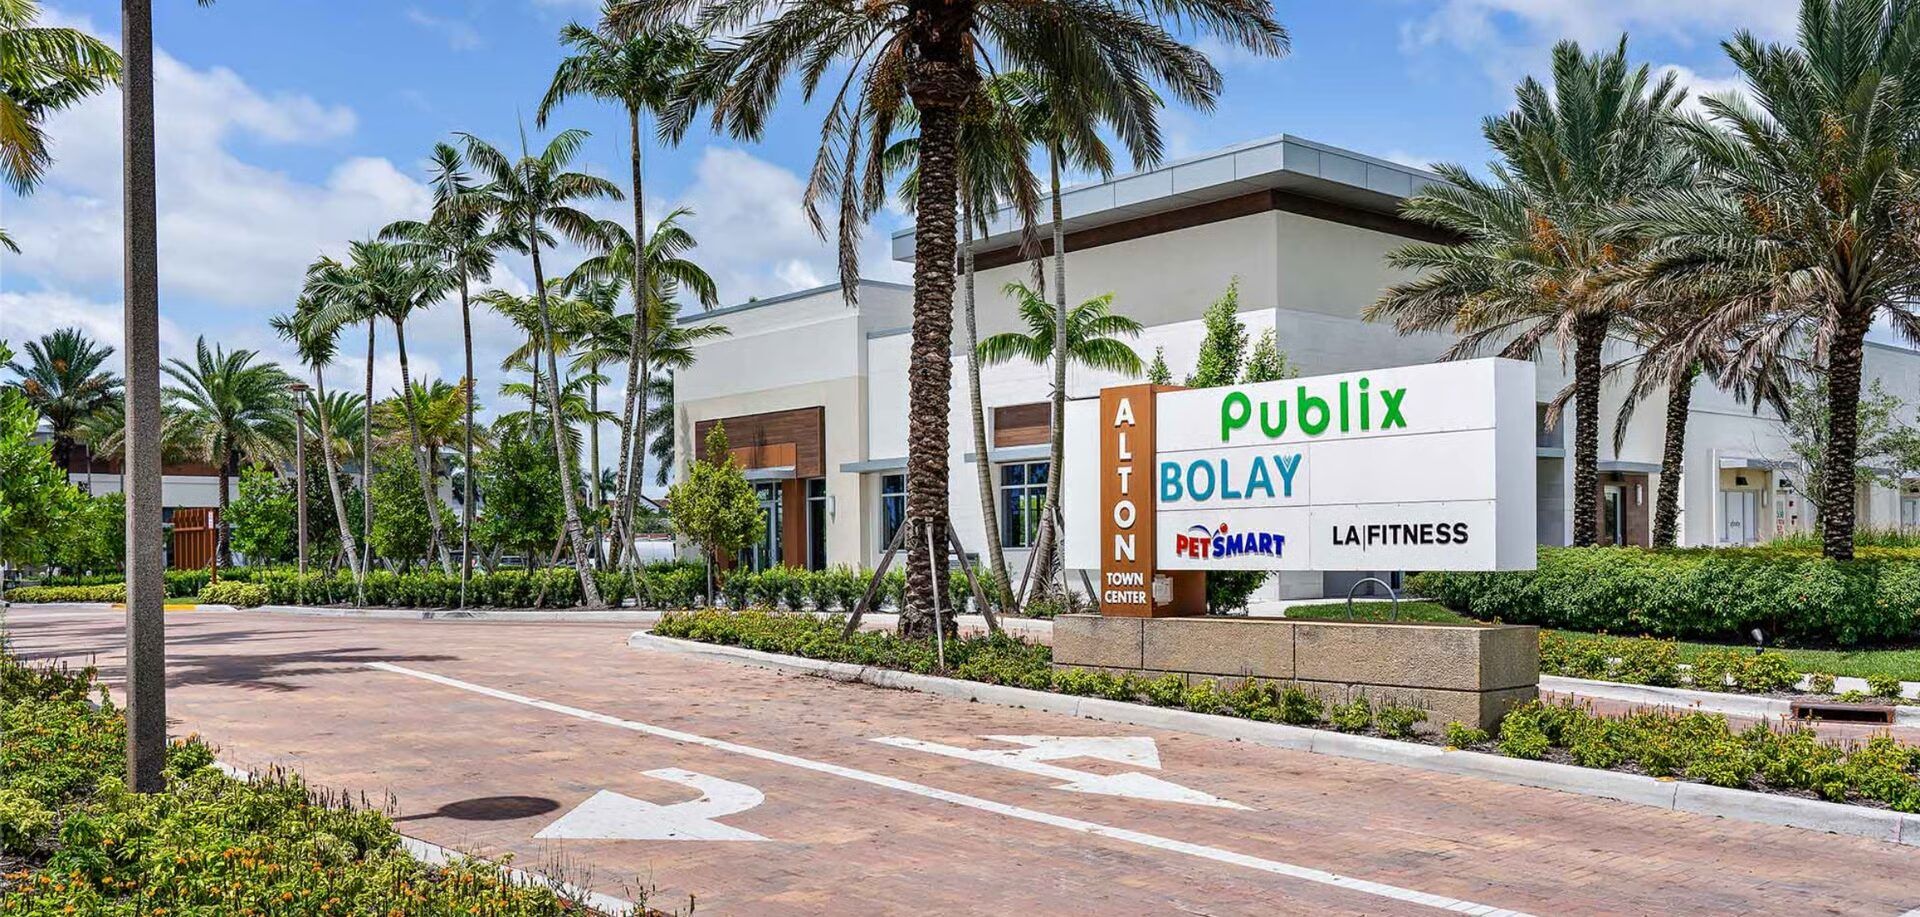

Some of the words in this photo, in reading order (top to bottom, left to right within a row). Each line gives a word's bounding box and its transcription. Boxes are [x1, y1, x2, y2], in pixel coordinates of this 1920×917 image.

[1221, 377, 1407, 442] Publix
[1114, 397, 1136, 562] ALTON
[1160, 452, 1302, 502] BOLAY
[1104, 589, 1147, 605] CENTER
[1106, 572, 1144, 586] TOWN
